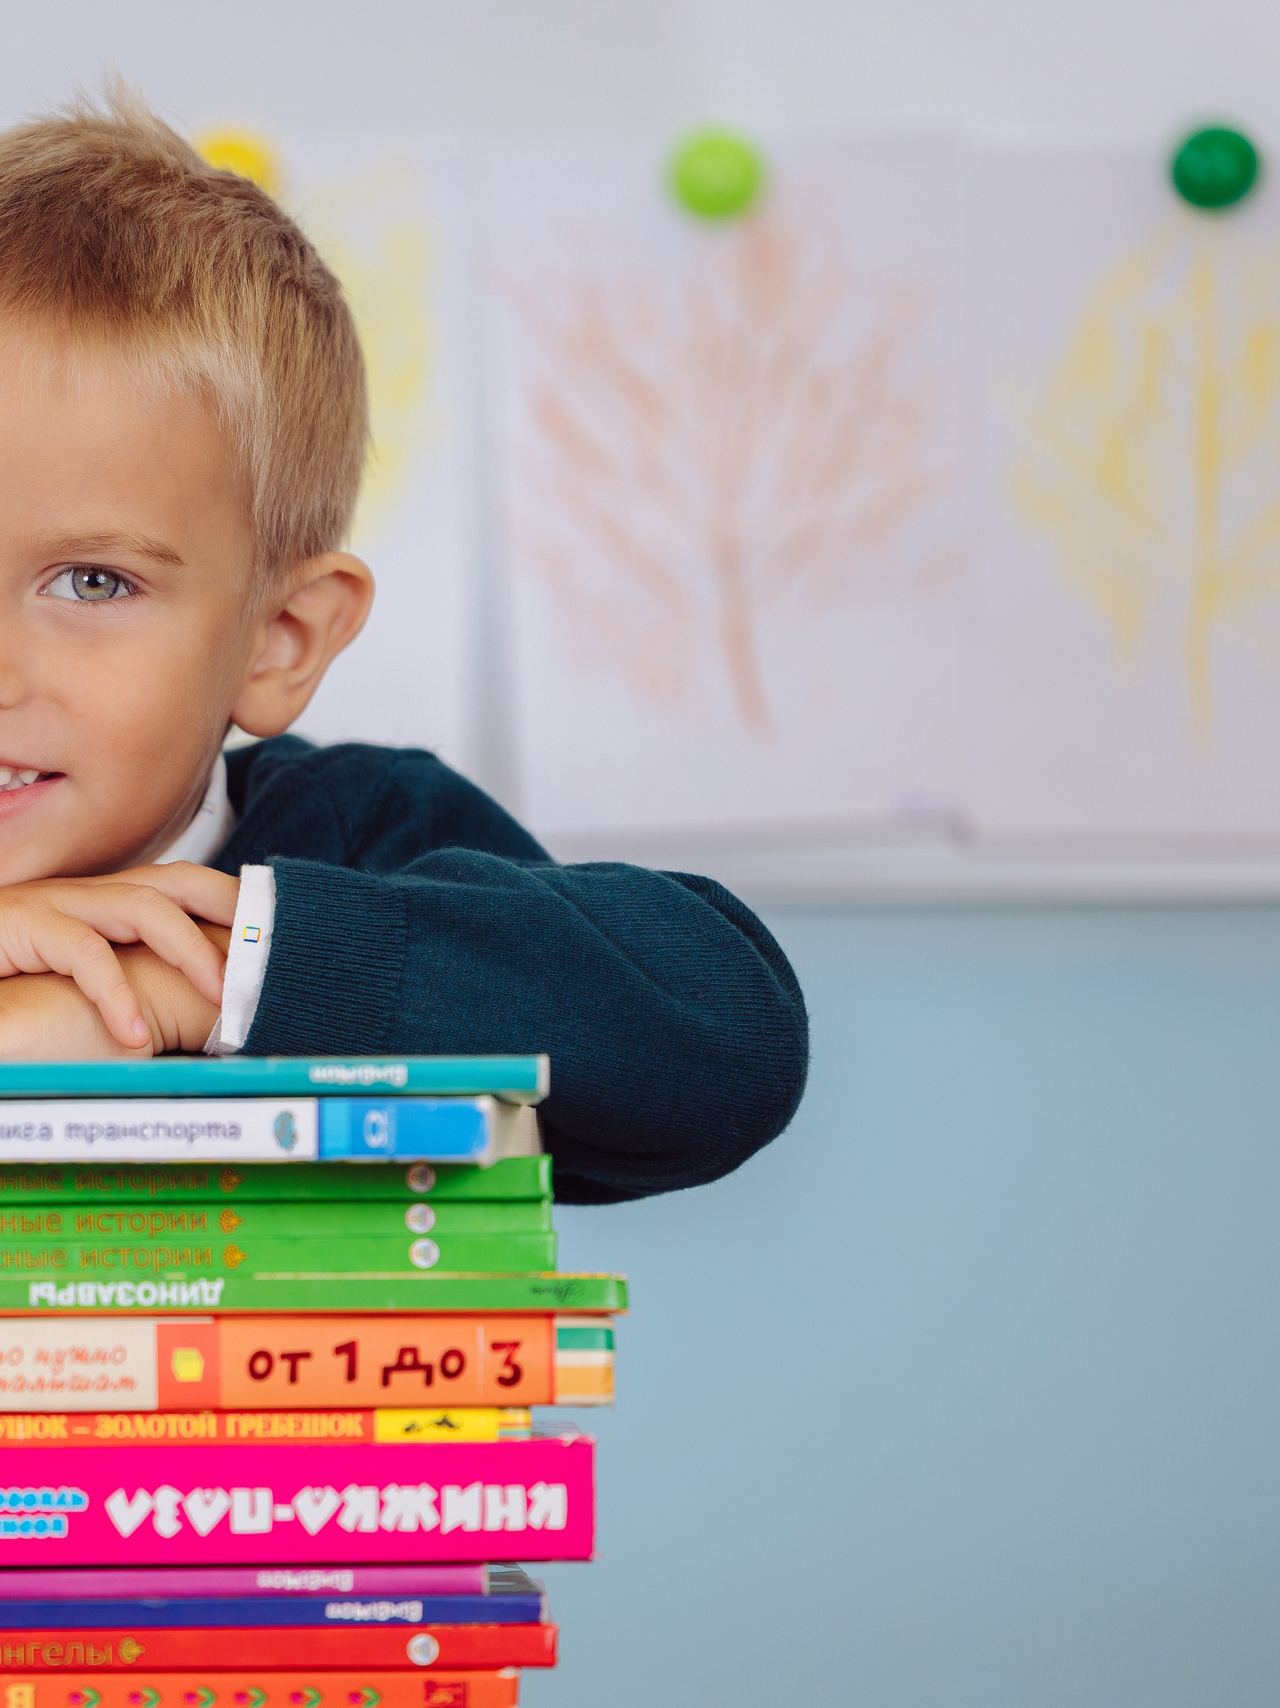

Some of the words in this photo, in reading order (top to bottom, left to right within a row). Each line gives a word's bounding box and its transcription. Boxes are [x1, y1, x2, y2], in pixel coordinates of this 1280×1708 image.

[63, 1121, 243, 1147] транспорта
[75, 1168, 210, 1197] истории
[75, 1211, 210, 1239] истории
[78, 1246, 213, 1274] истории
[28, 1279, 226, 1308] ДИНОЗАВРЫ
[33, 1344, 127, 1376] нужно
[248, 1350, 312, 1383] от
[333, 1340, 358, 1382] 1
[382, 1346, 466, 1388] до
[491, 1341, 523, 1387] 3
[94, 1410, 218, 1439] ЗОЛОТОЙ
[226, 1413, 363, 1438] ГРЕБЕШОК
[105, 1480, 569, 1539] КНИЖКА-ПАЗЛ
